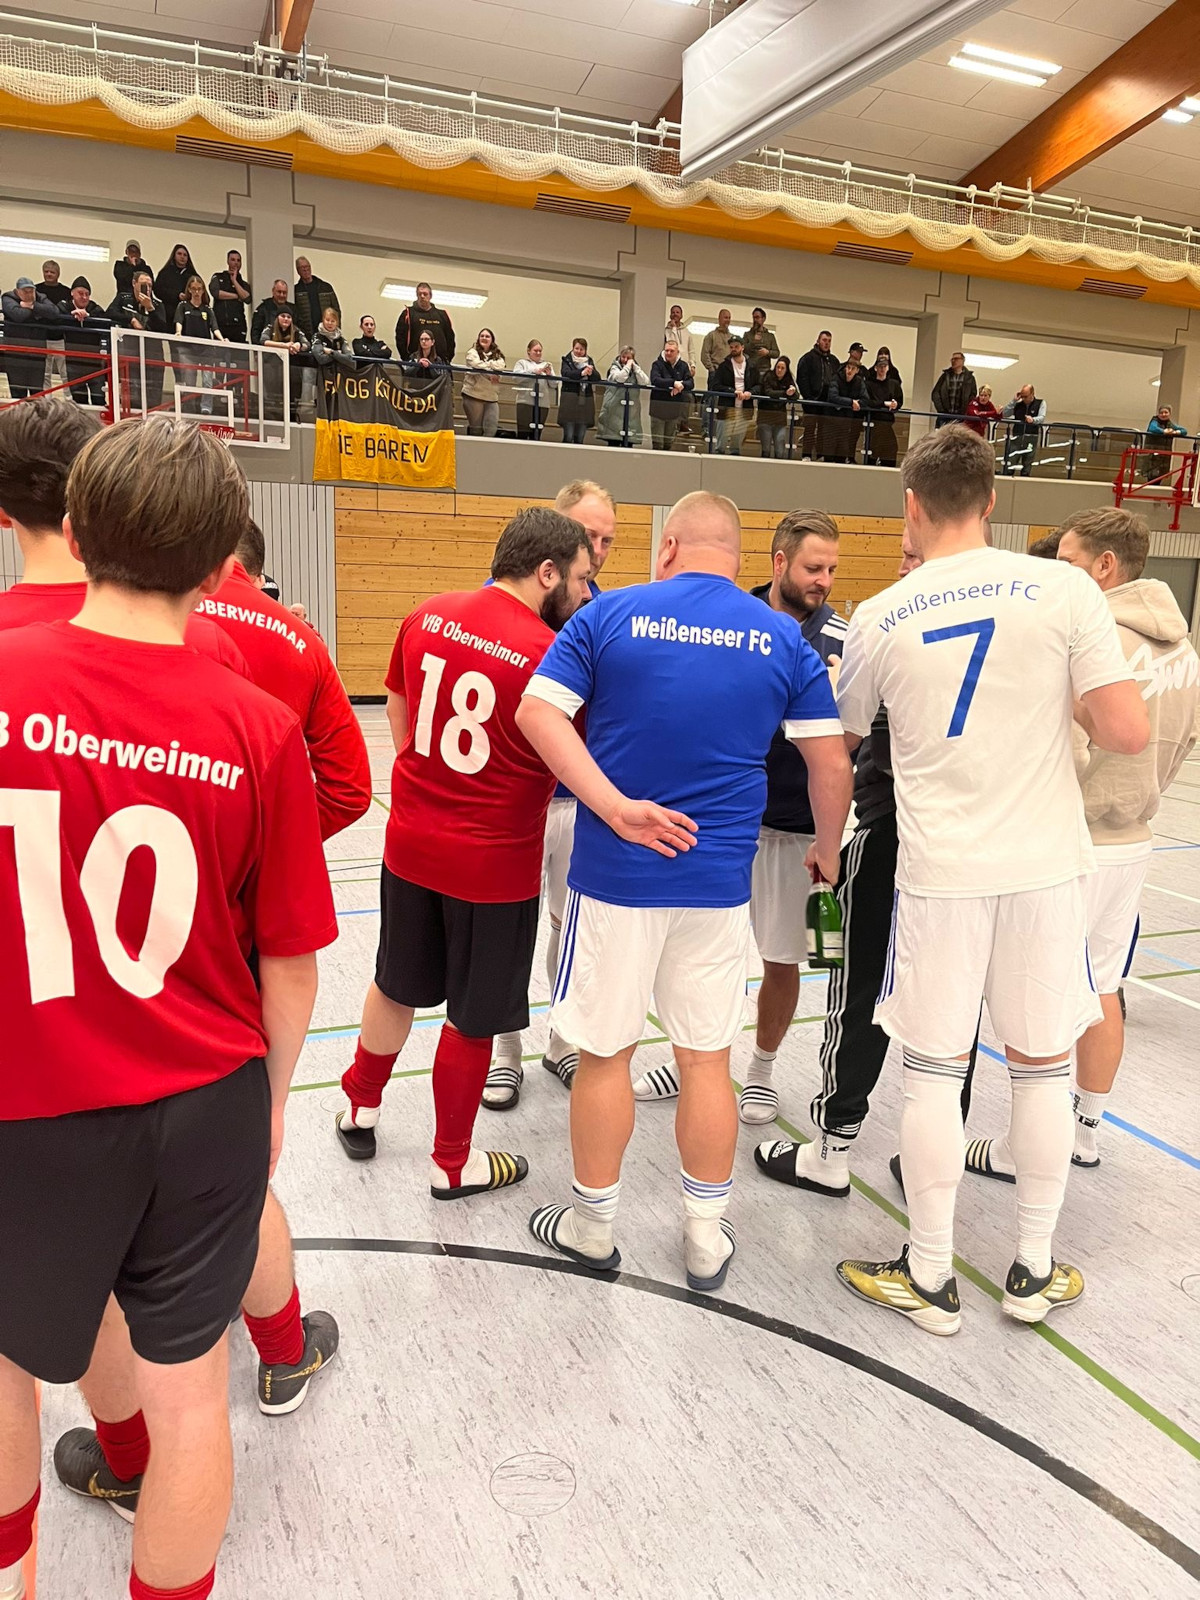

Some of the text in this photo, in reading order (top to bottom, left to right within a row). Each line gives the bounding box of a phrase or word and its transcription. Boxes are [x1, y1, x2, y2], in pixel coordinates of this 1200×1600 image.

[365, 433, 429, 464] BÄREN
[421, 612, 531, 669] VfB Oberweimar
[631, 615, 773, 656] Weißenseer FC
[879, 580, 1041, 634] Weißenseer FC
[921, 617, 996, 738] 7
[414, 652, 497, 775] 18
[22, 713, 245, 791] Oberweimar
[0, 787, 199, 1005] 10
